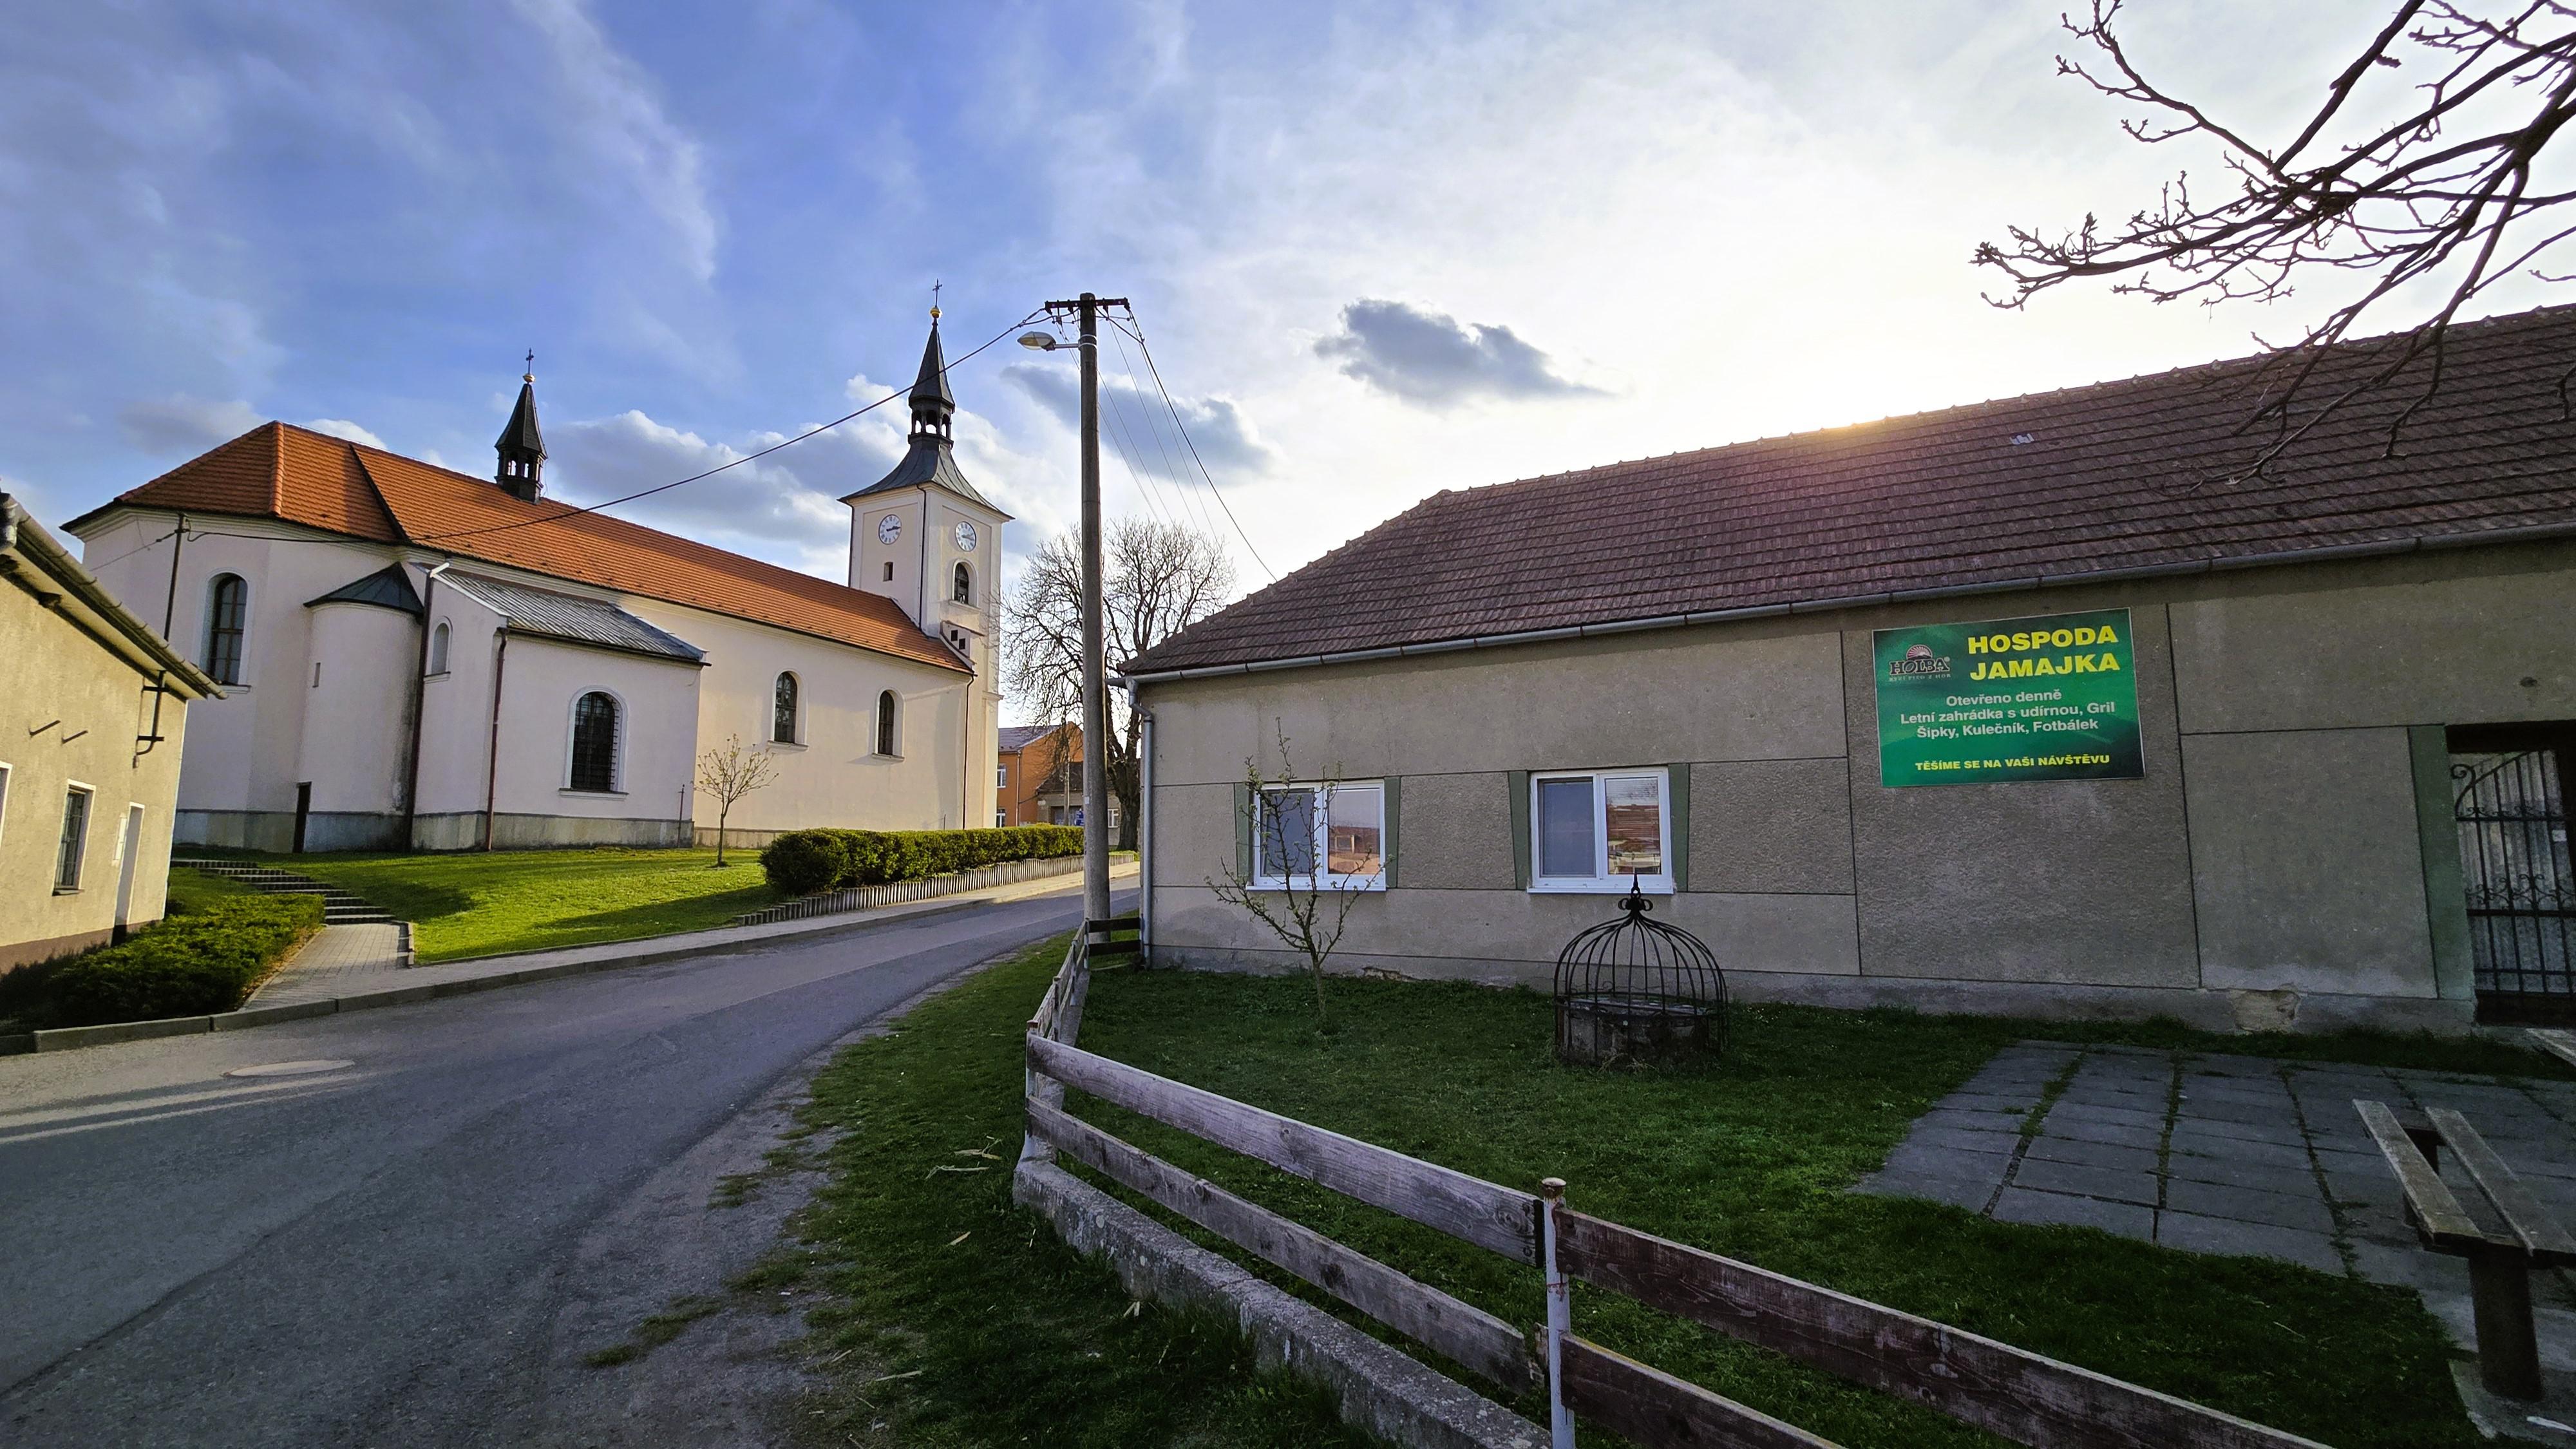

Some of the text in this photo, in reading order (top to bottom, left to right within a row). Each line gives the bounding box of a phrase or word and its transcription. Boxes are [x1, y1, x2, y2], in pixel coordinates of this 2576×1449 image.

[1968, 625, 2119, 654] HOSPODA
[1889, 658, 1950, 675] HOLBA
[1970, 652, 2120, 681] JAMAJKA
[1946, 688, 2062, 707] Otevřeno denně
[1900, 701, 2115, 724] Letní zahrádka s udírnou, Gril
[1917, 719, 2099, 739] Šipky, Kulečník, Fotbálek
[1915, 755, 2110, 771] TĚŠÍME SE NA VAŠI NÁVŠTĚVU
